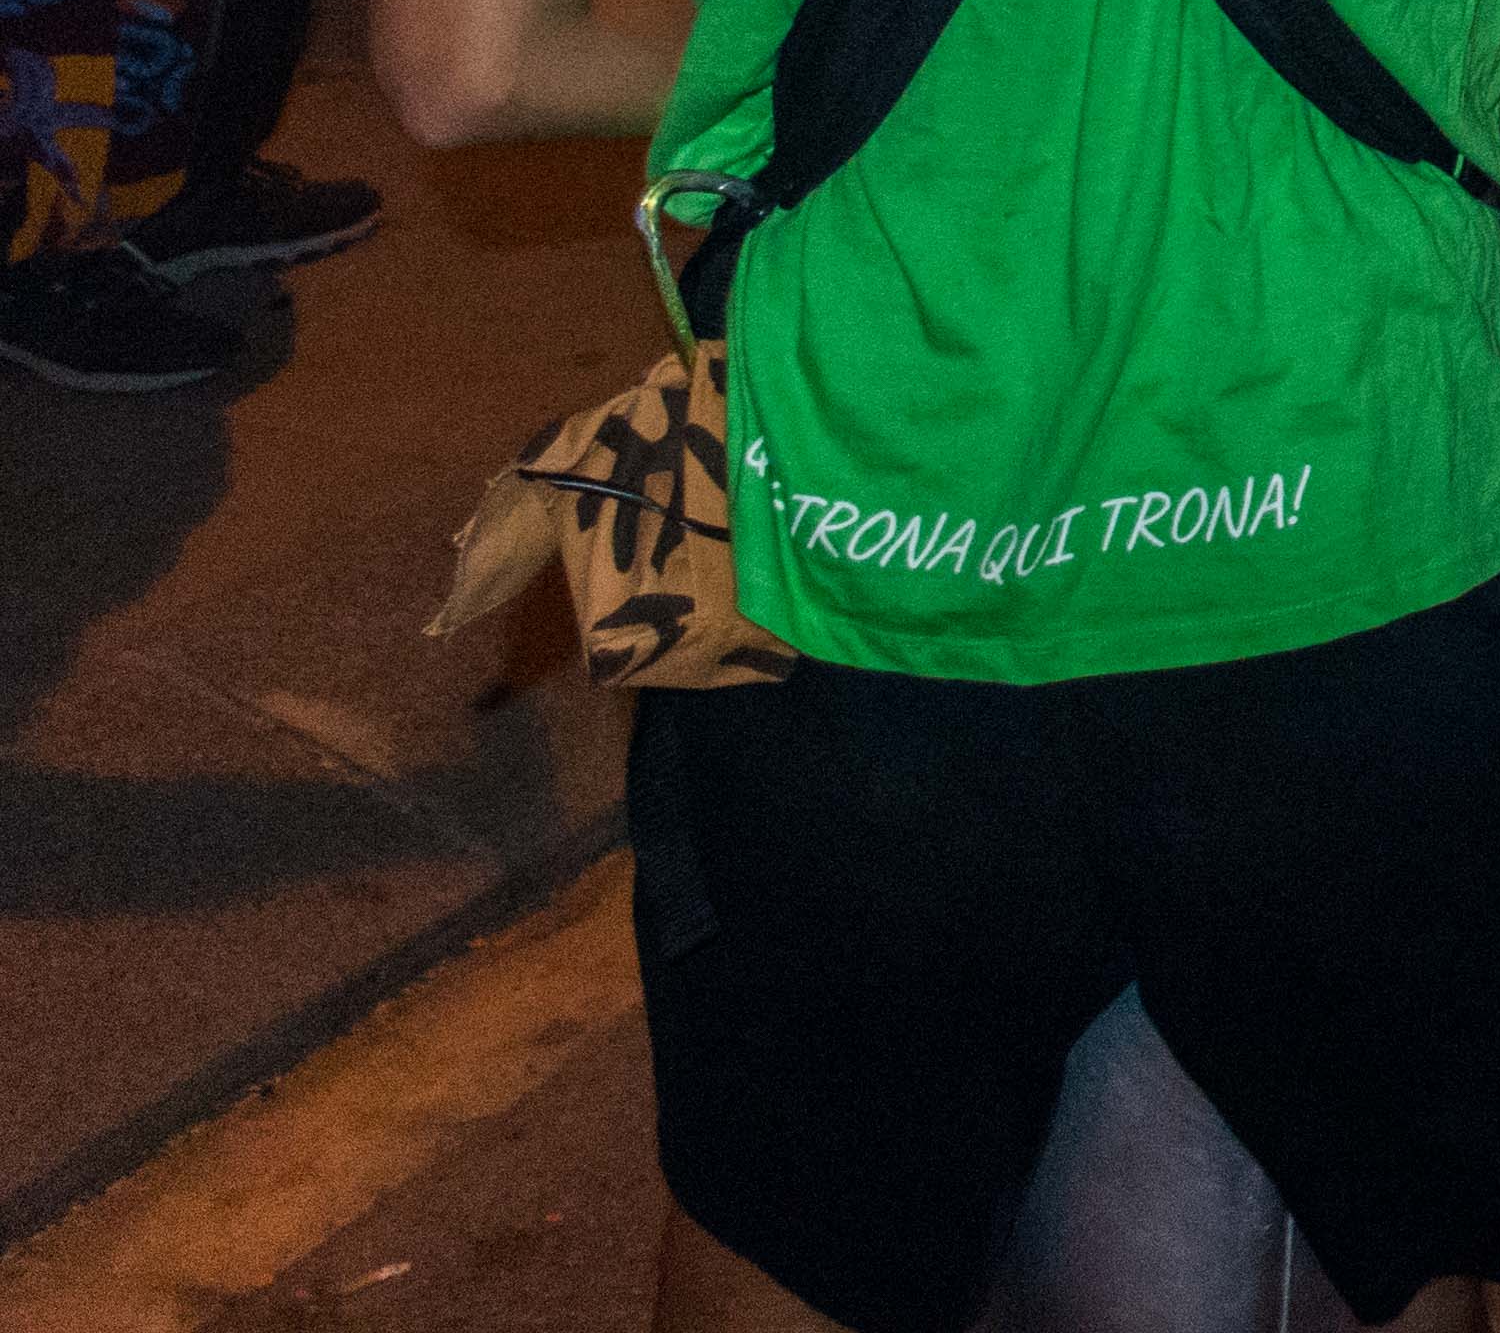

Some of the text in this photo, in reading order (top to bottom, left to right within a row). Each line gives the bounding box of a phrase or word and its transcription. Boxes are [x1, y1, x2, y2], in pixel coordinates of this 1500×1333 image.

[790, 493, 977, 575] TRONA
[978, 504, 1087, 586] QUI
[1099, 464, 1313, 555] TRONA!
